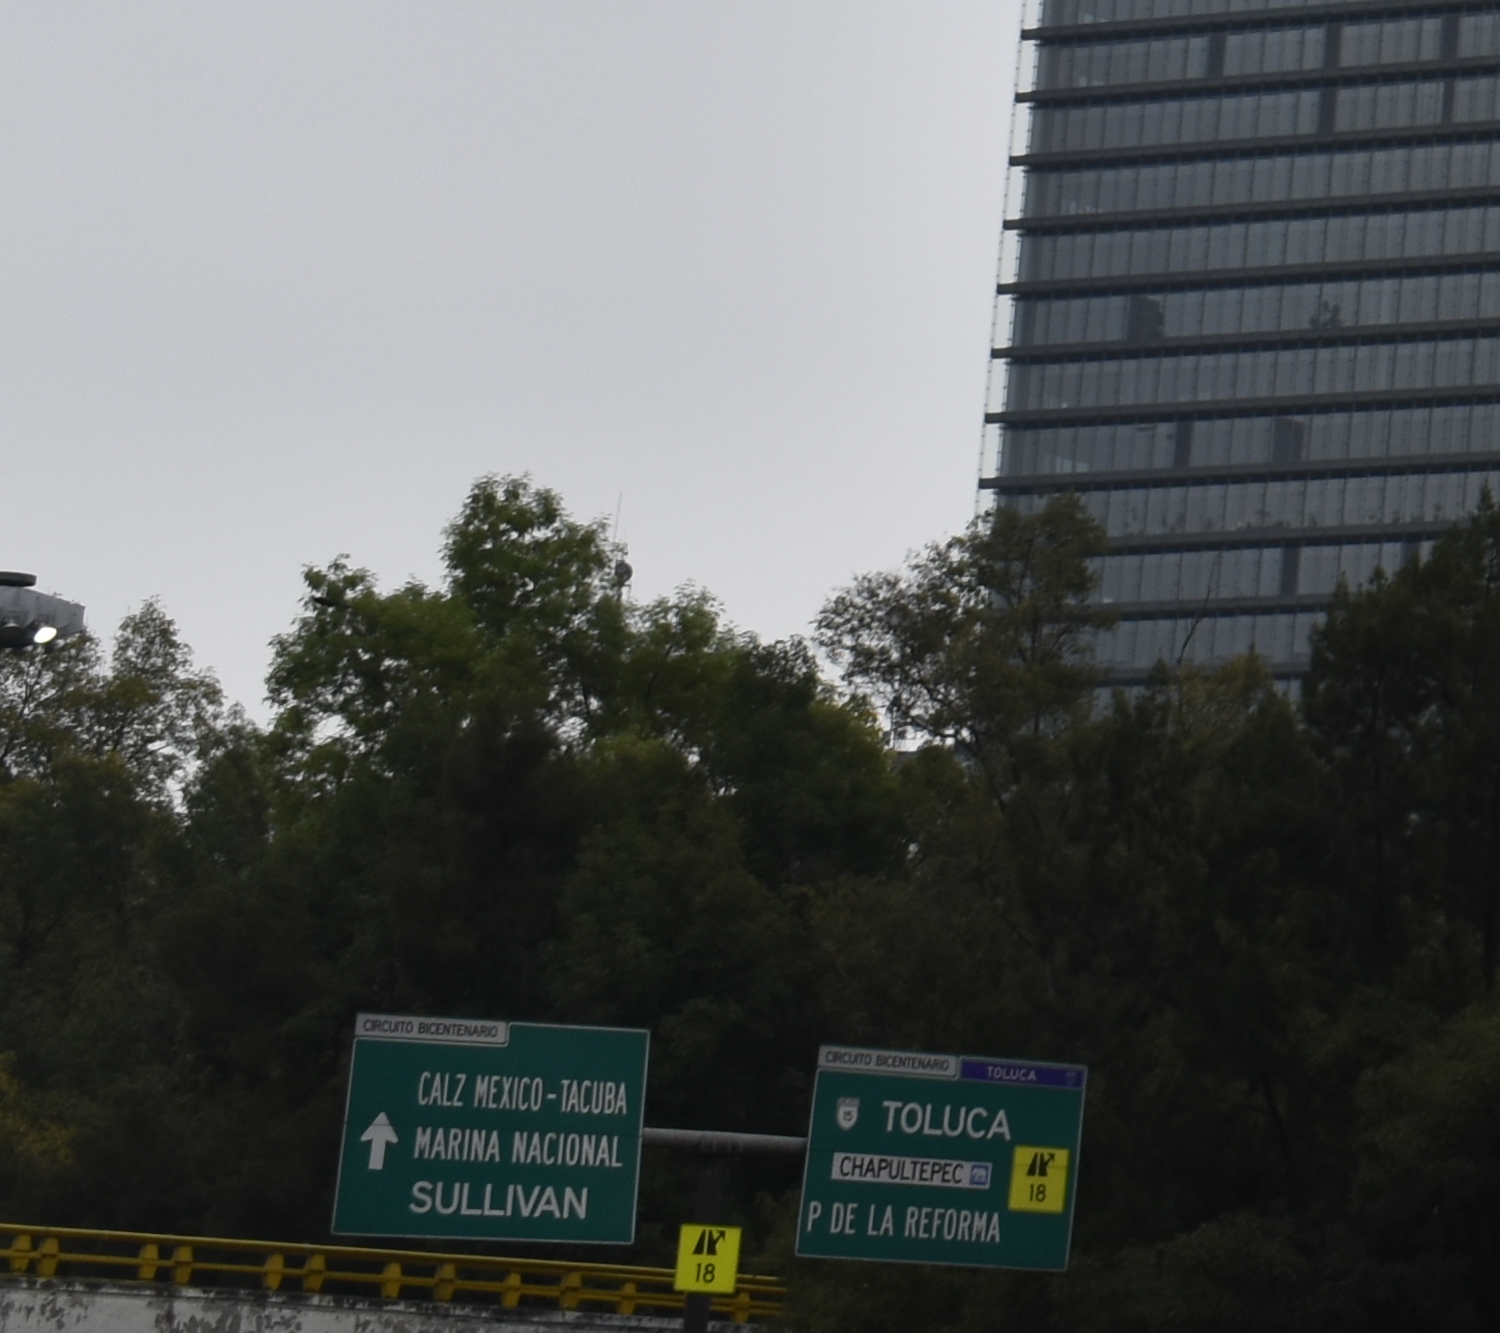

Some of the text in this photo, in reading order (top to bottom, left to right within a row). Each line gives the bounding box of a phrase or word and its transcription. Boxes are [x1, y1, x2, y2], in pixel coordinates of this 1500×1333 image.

[363, 1019, 499, 1038] CIRCUITO BICENTENARIO
[825, 1050, 949, 1073] CIRCUITO BICENTENARIO
[986, 1066, 1037, 1082] TOLUCA
[418, 1071, 466, 1107] CALZ
[882, 1100, 1012, 1141] TOLUCA
[414, 1126, 623, 1167] MARINA NACIONAL
[839, 1155, 964, 1184] CHAPULTEPEC
[409, 1180, 588, 1220] SULLIVAN
[1028, 1183, 1046, 1203] 18
[807, 1200, 1001, 1244] P DE LA REFORMA
[695, 1262, 716, 1284] 18
